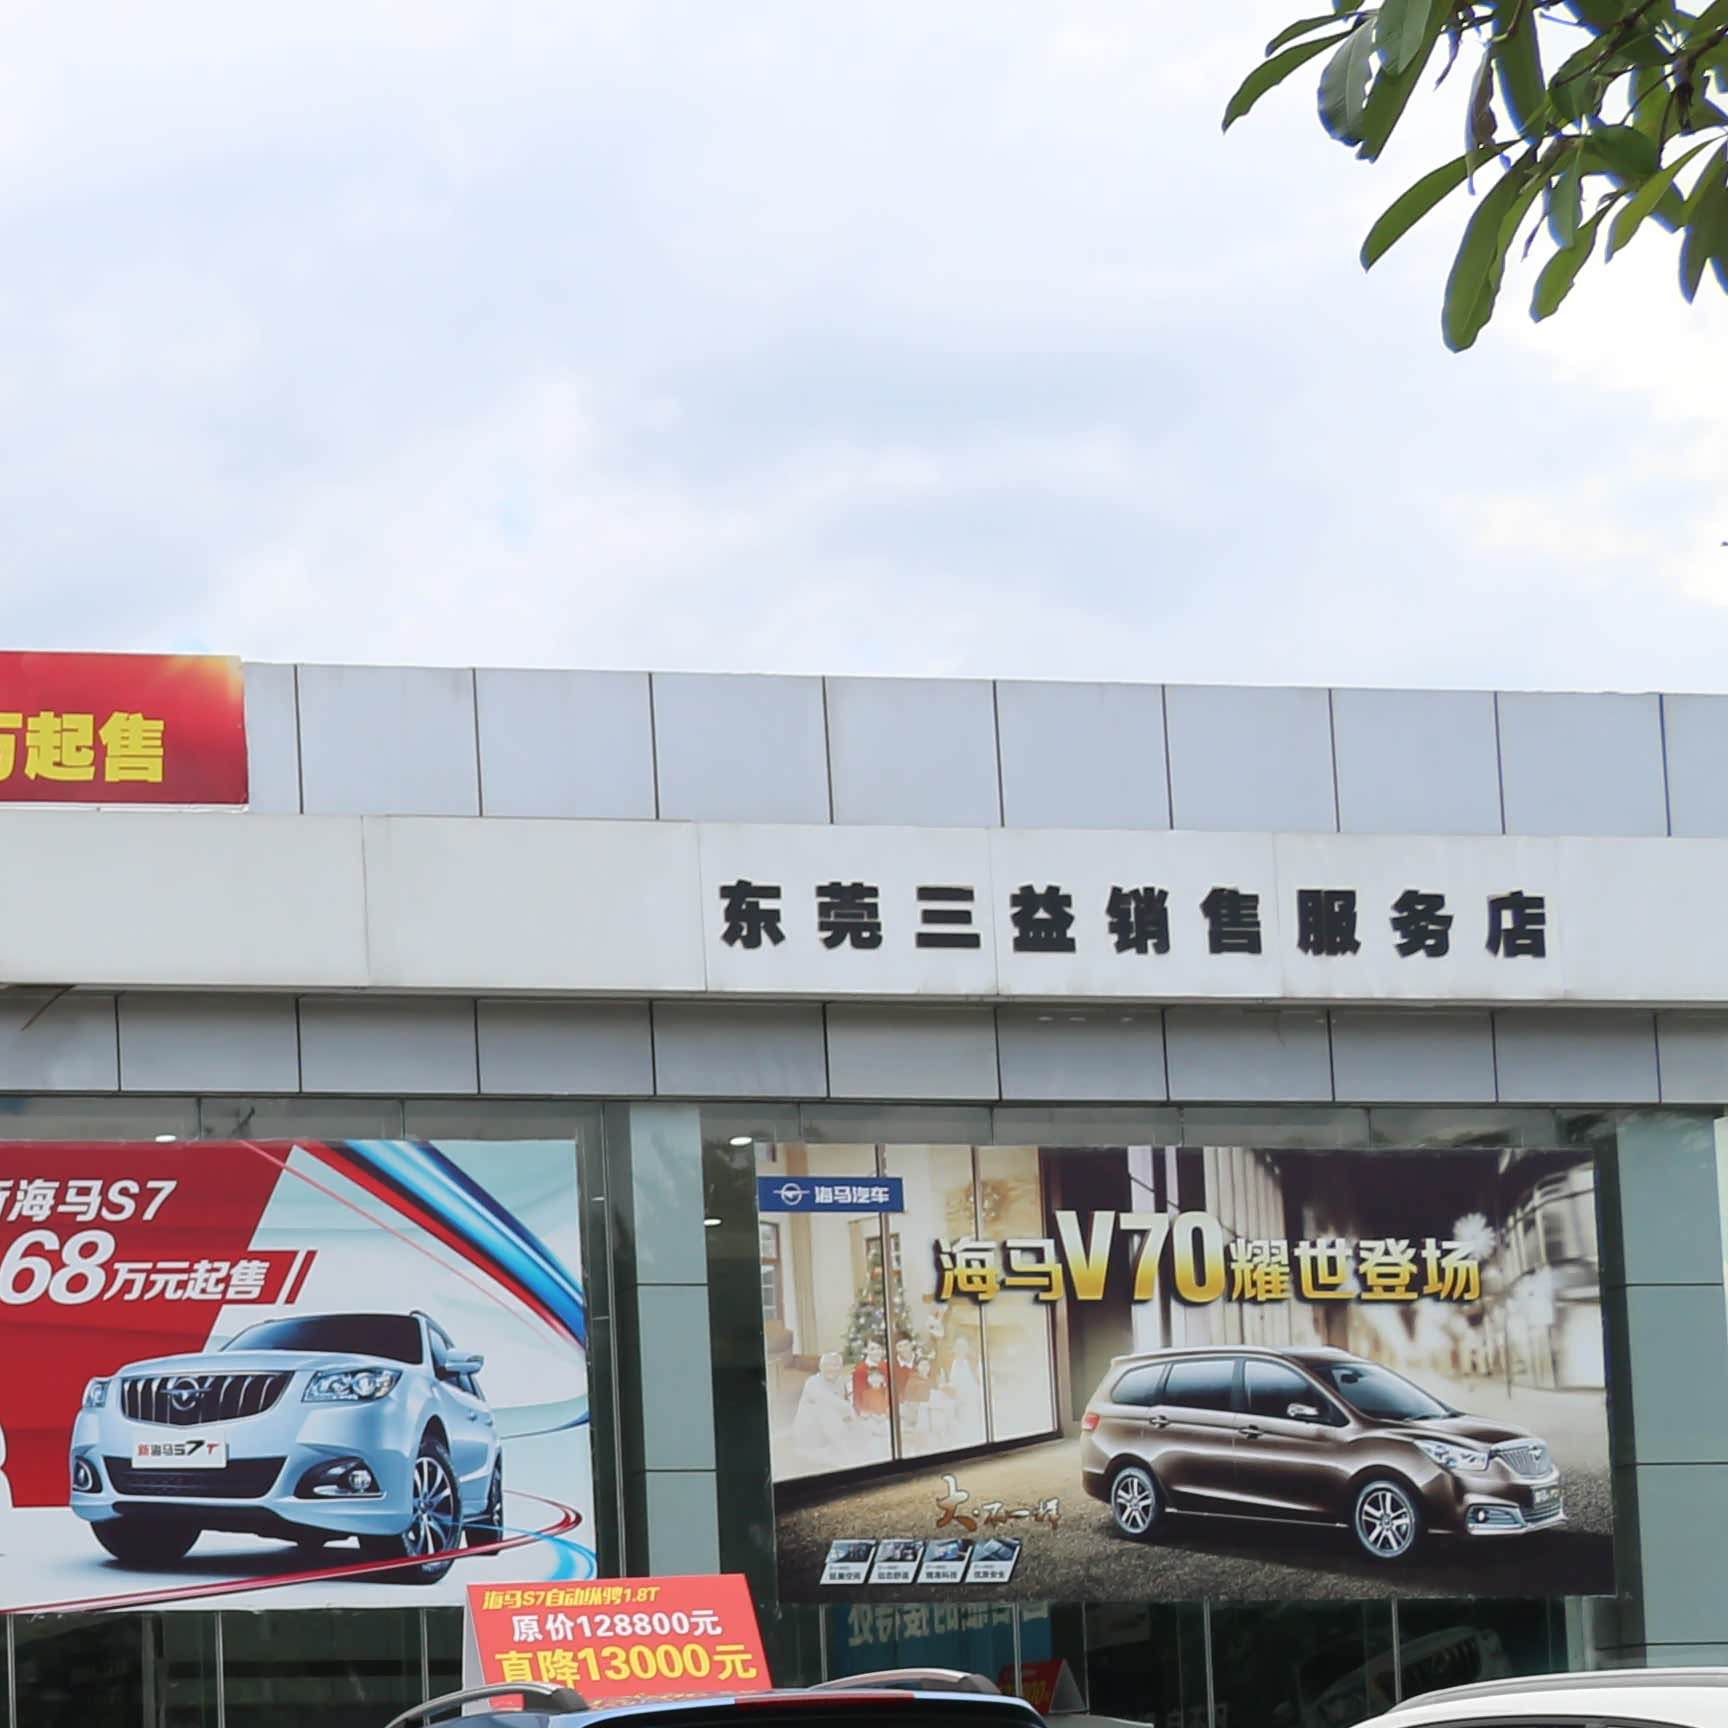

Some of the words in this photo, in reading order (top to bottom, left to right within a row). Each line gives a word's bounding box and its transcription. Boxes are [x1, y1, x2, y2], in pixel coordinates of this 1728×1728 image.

[718, 879, 1549, 959] 东莞三益销售服务店
[813, 1184, 891, 1206] 海马汽车
[932, 1209, 1484, 1307] 海马V70耀世登场
[511, 1608, 723, 1643] 原价128800元
[494, 1643, 758, 1688] 直降13000元
